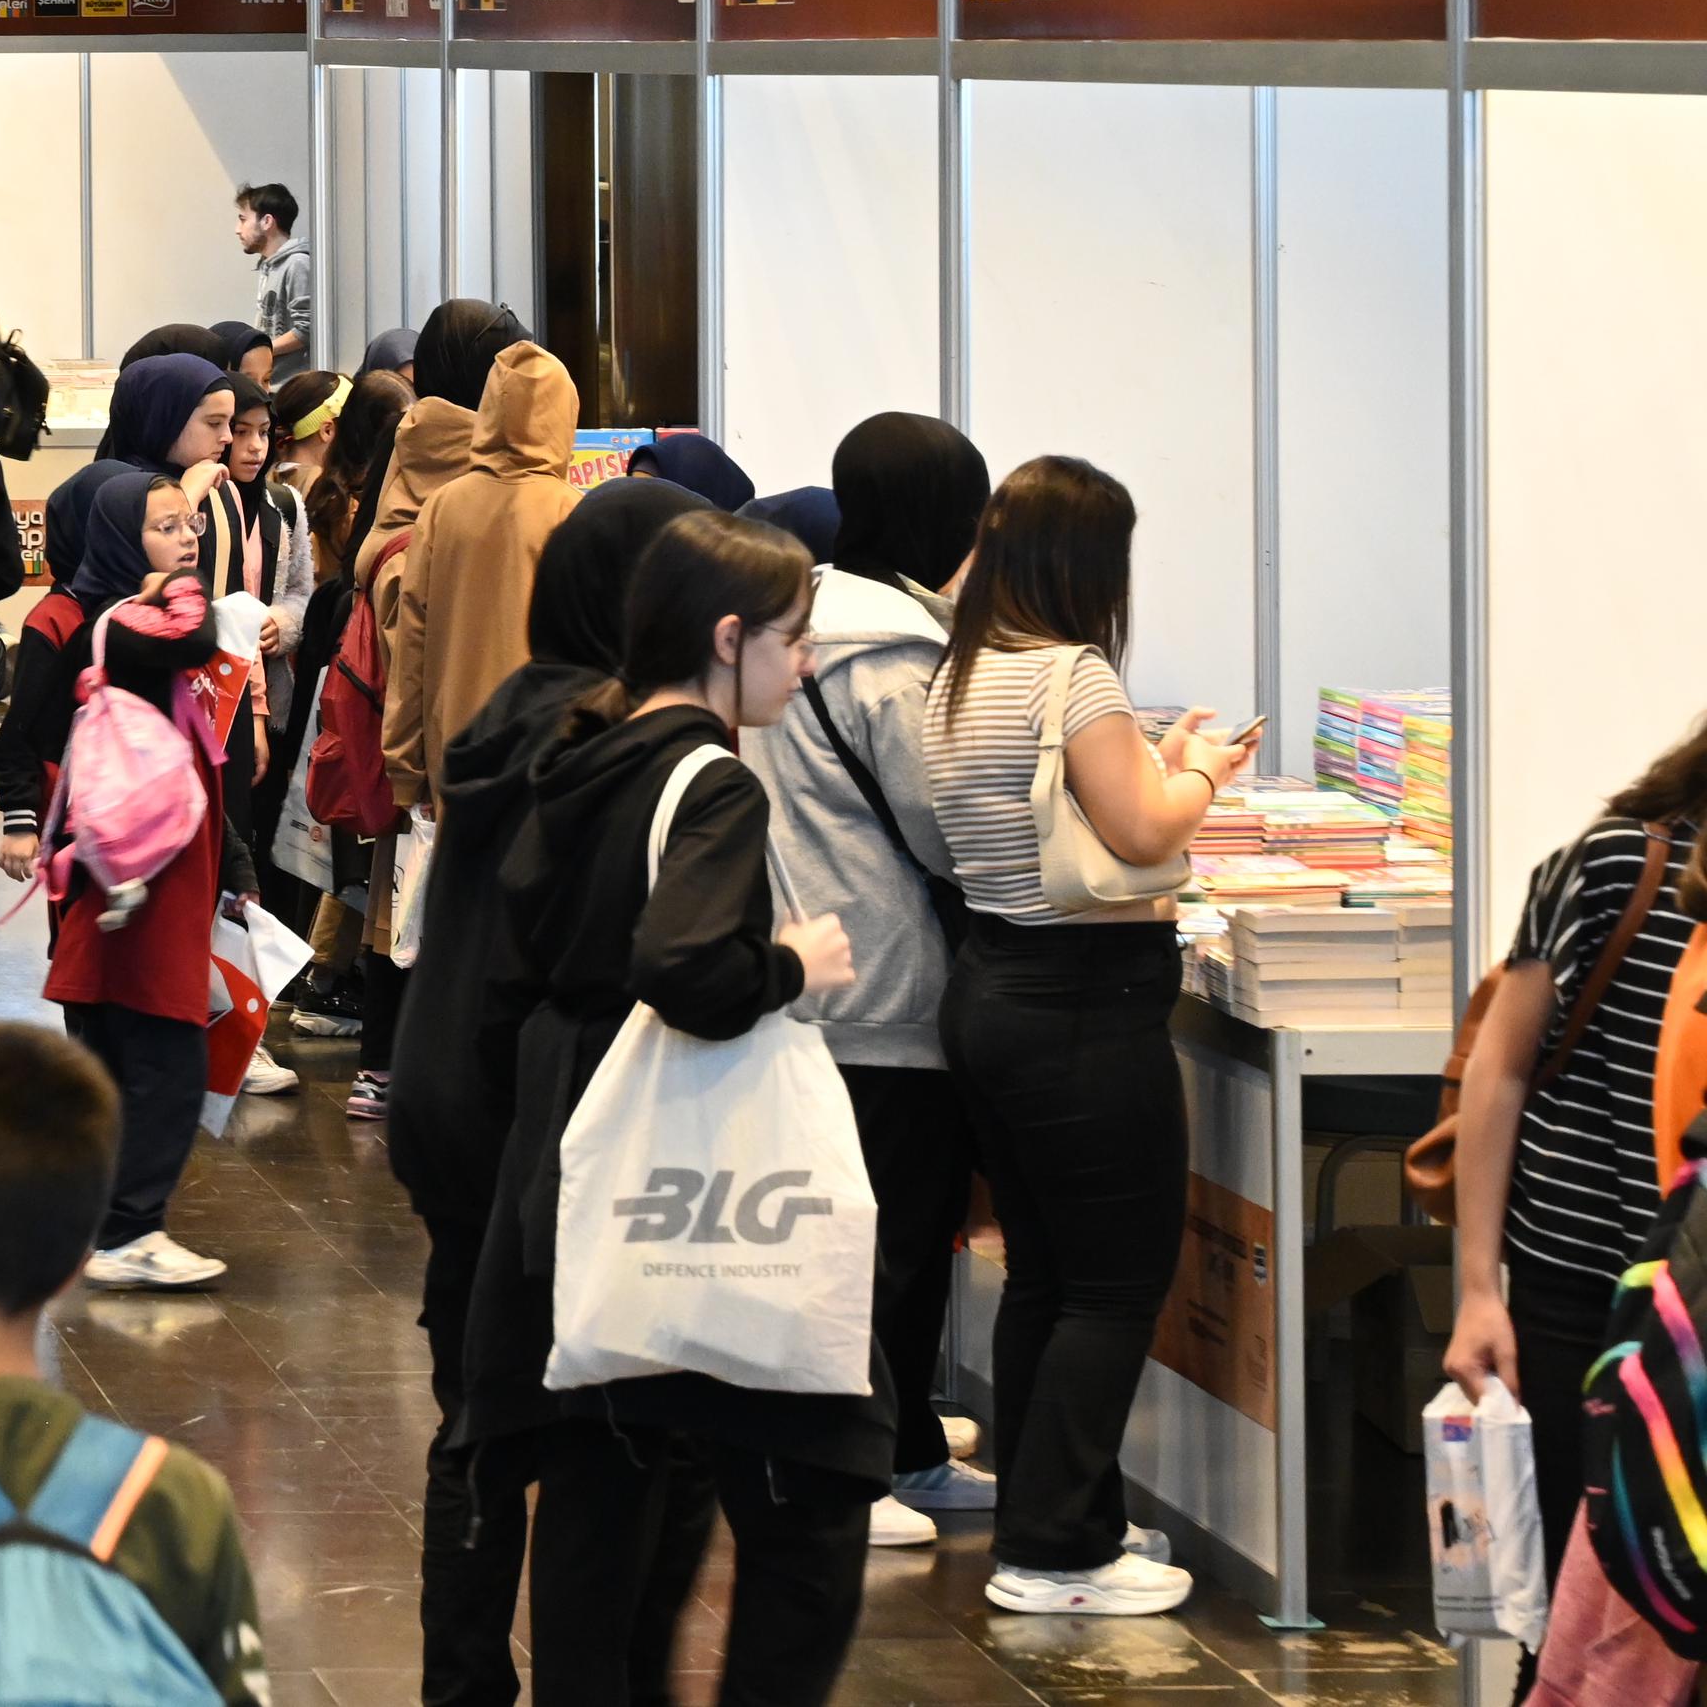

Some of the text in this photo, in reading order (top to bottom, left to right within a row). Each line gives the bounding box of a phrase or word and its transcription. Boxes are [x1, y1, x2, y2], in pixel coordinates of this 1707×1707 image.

[613, 1167, 833, 1246] BLG
[642, 1262, 803, 1279] DEFENCE INDUSTRY
